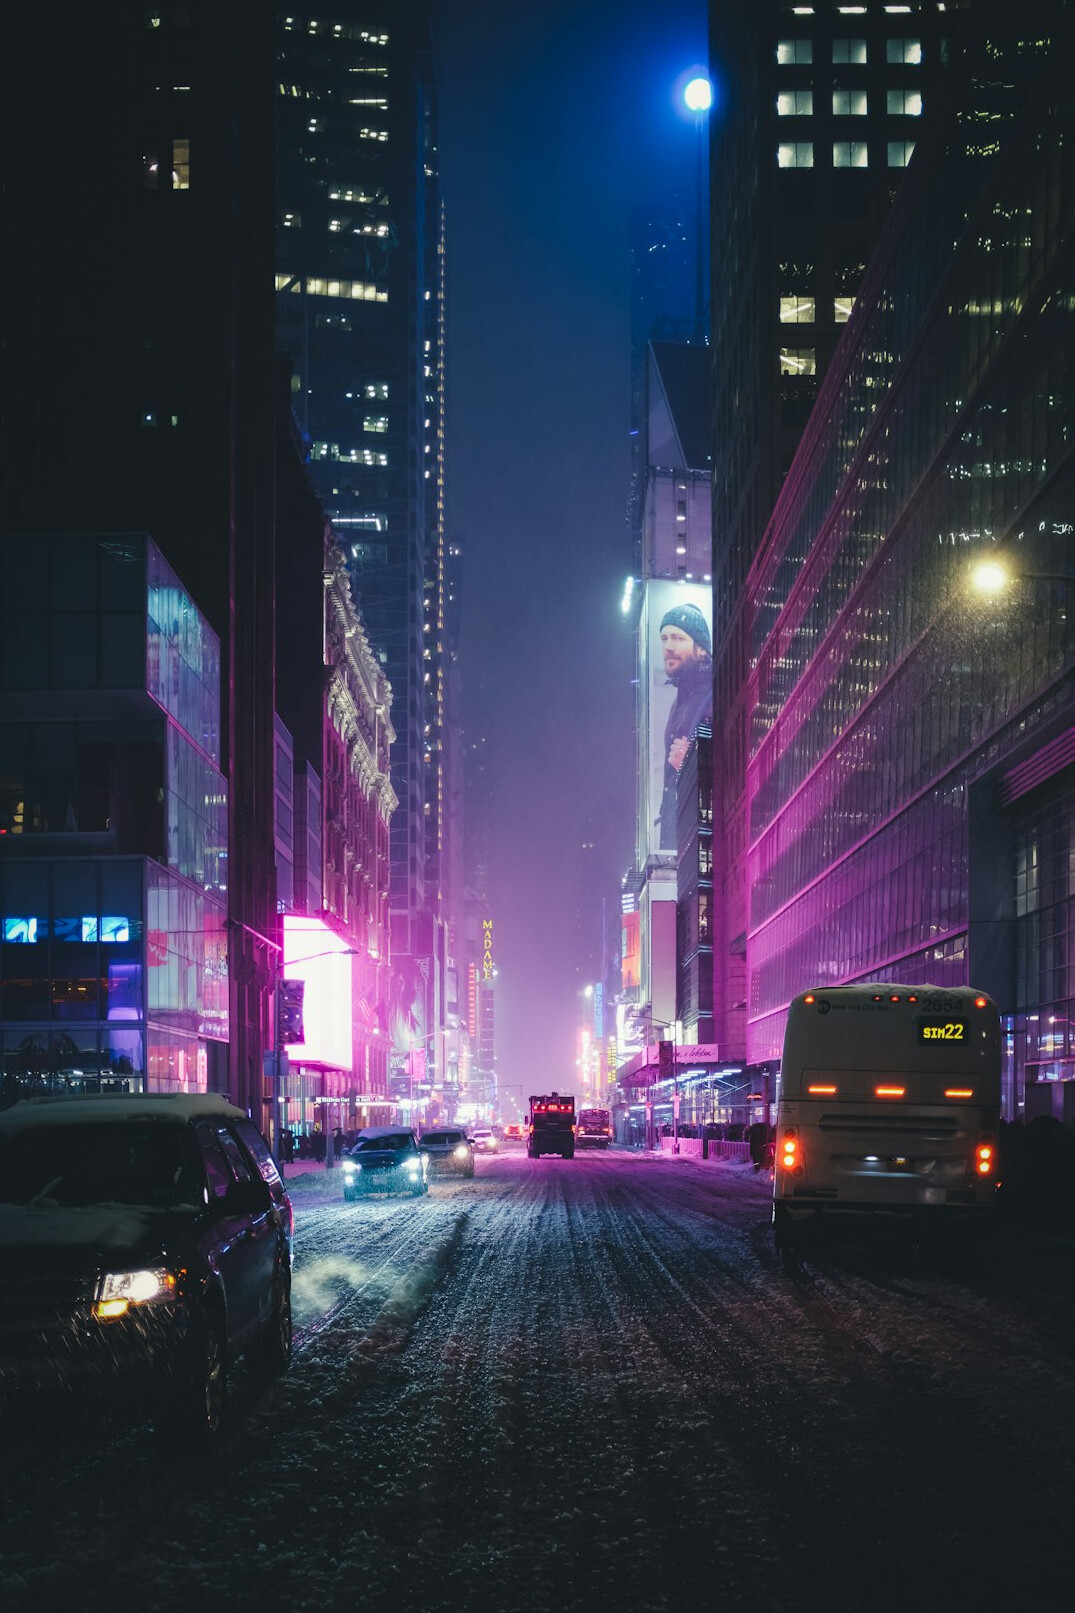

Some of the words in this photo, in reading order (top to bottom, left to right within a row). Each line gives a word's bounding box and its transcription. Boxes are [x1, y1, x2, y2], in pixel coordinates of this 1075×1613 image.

[483, 919, 493, 979] MADAME
[921, 998, 964, 1012] 2654
[923, 1023, 963, 1039] SIM22
